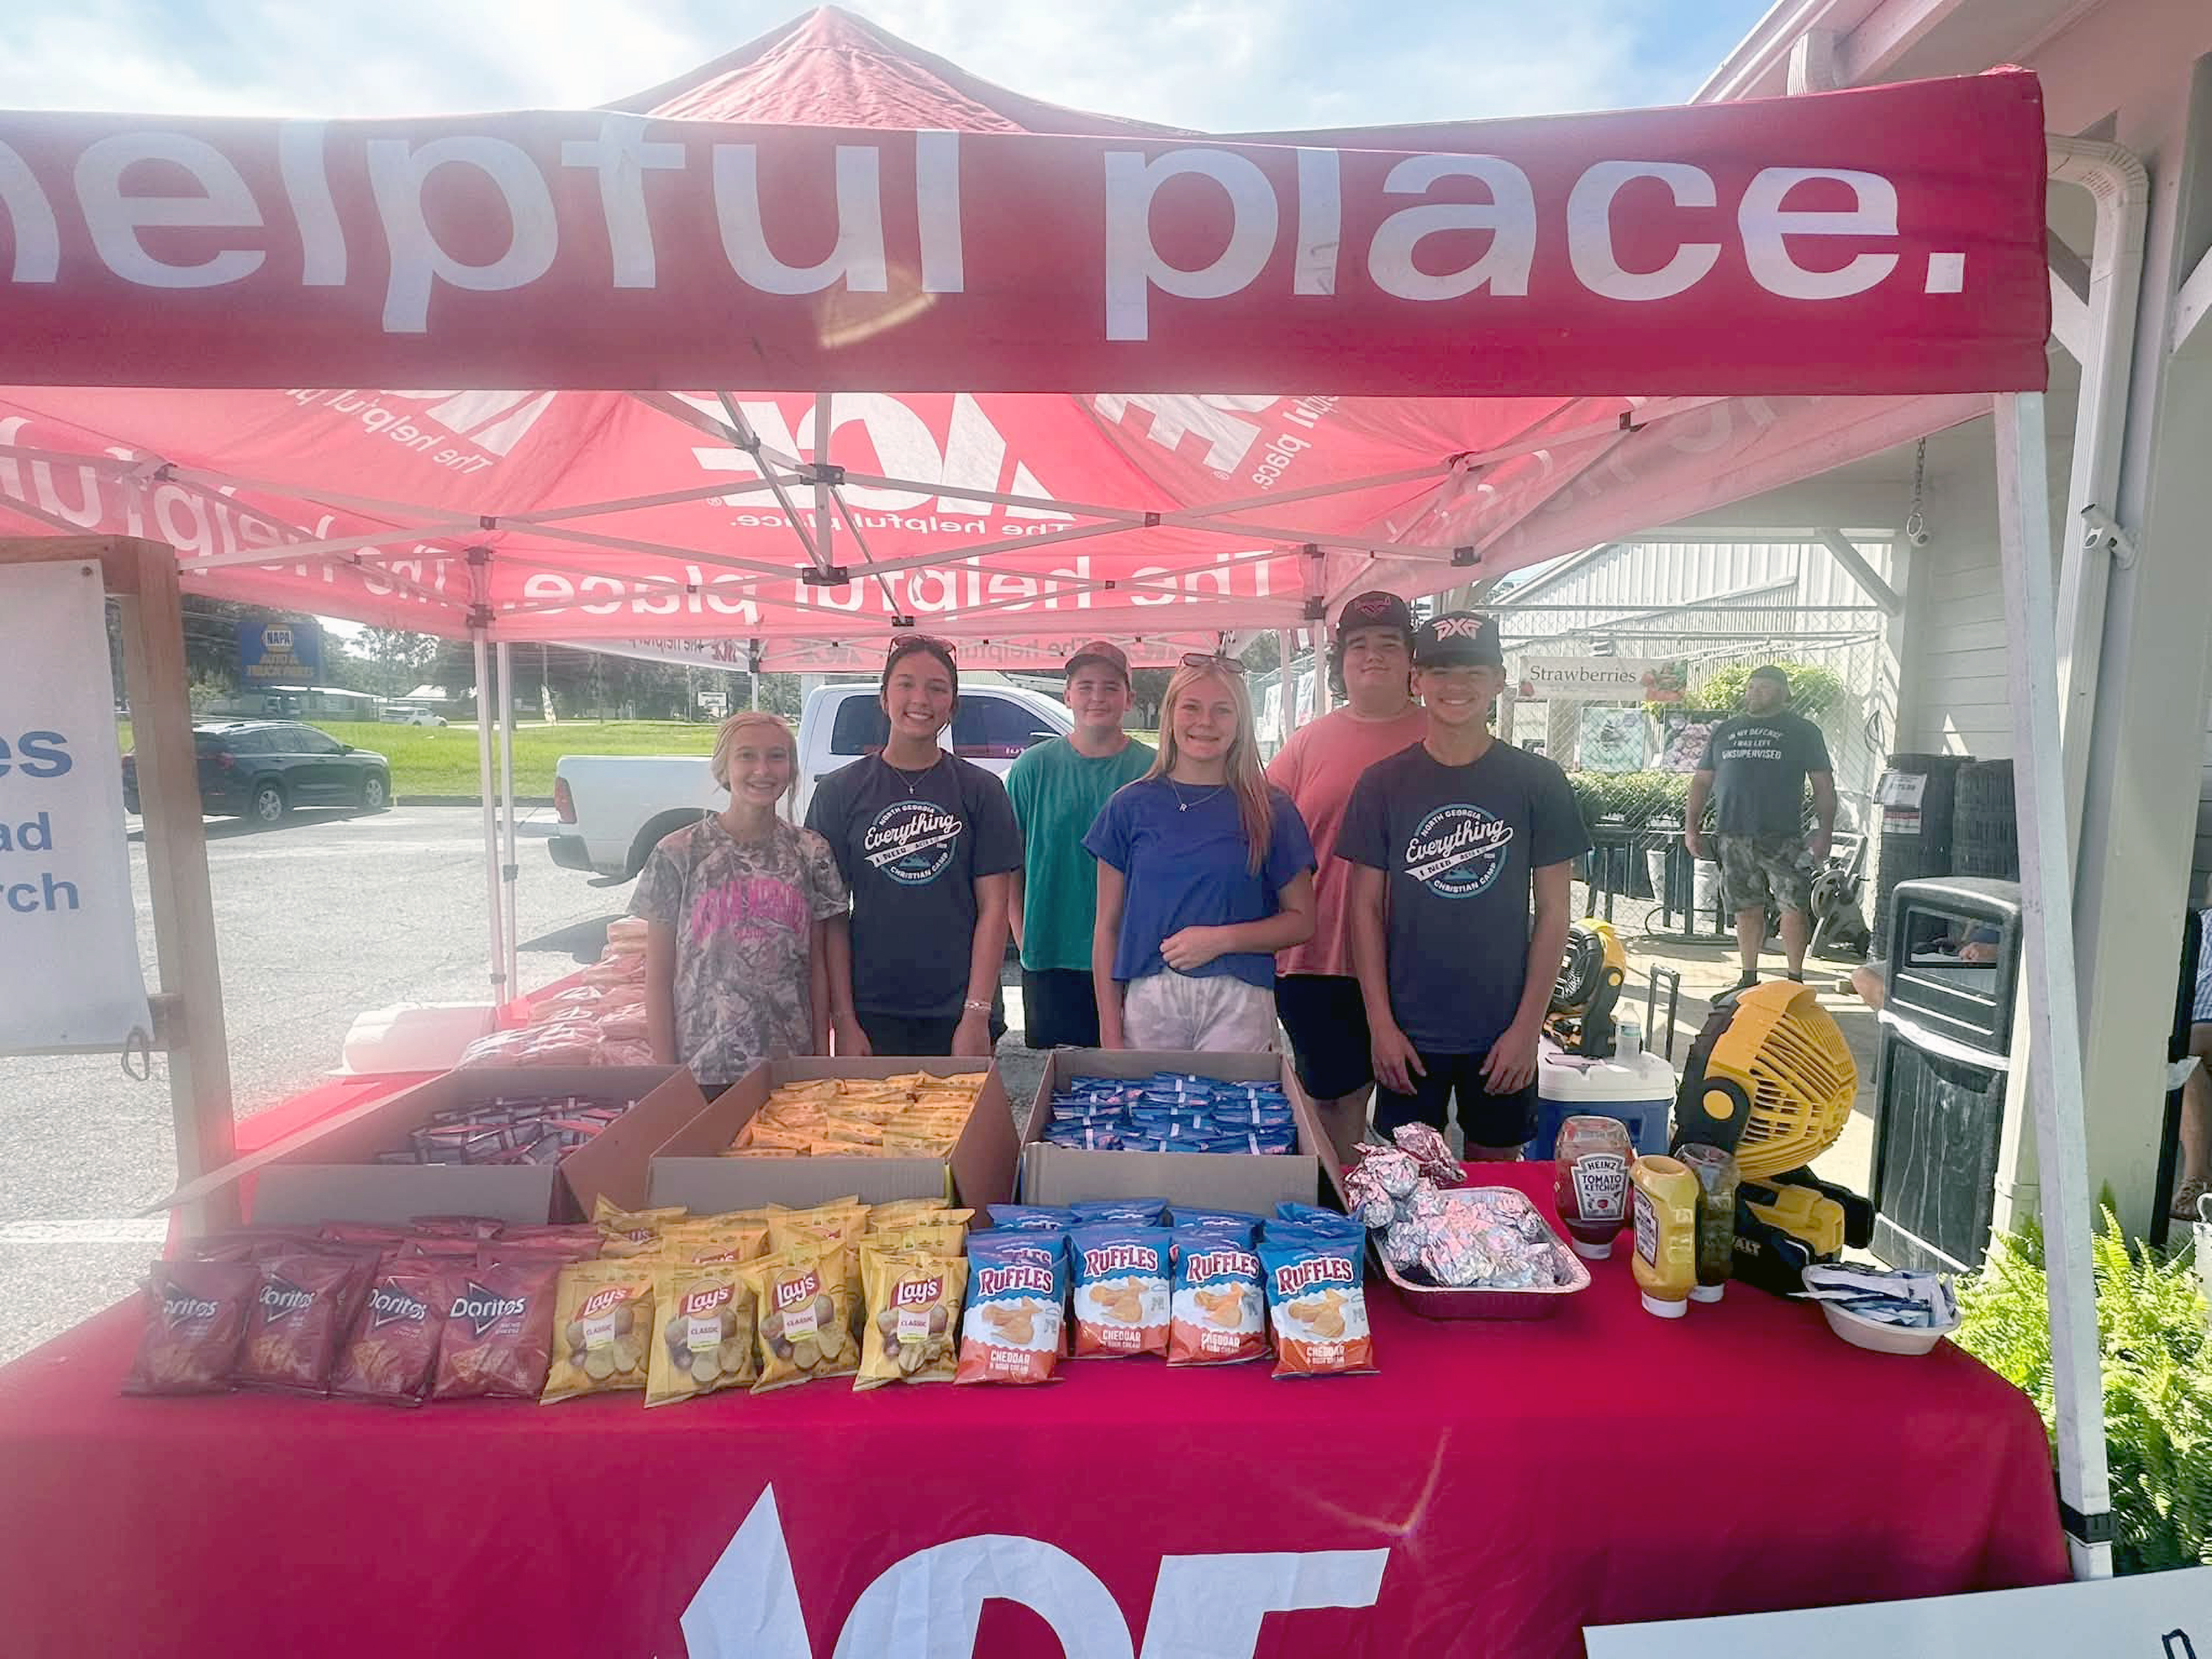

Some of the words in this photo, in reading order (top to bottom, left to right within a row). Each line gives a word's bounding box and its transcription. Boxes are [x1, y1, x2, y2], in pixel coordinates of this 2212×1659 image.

[1103, 146, 1966, 341] place.
[1530, 665, 1637, 683] Strawberries
[0, 731, 72, 778] s
[1722, 749, 1781, 760] UNSUPERVISED
[901, 804, 934, 813] GEORGIA
[864, 812, 962, 851] Everything
[1421, 814, 1444, 837] NORTH
[1445, 809, 1481, 820] GEORGIA
[1405, 819, 1513, 863] Everything
[890, 866, 931, 880] CHRISTIAN
[931, 852, 949, 872] CAMP
[1433, 880, 1479, 893] CHRISTIAN
[1479, 862, 1496, 885] CAMP
[0, 872, 80, 913] ch
[1582, 1175, 1622, 1184] TOMATO
[1587, 1161, 1616, 1170] HEINZ
[1585, 1183, 1621, 1192] KETCHUP
[1084, 1245, 1158, 1278] RUFFLES
[1187, 1252, 1261, 1283] RUFFLES
[979, 1266, 1054, 1296] RUFFLES
[1276, 1257, 1354, 1295] RUFFLES
[584, 1288, 627, 1316] Lay's
[686, 1287, 729, 1314] Lay's
[776, 1276, 815, 1308] Lay's
[897, 1279, 938, 1310] Lay's
[450, 1297, 526, 1318] Doritos
[1102, 1330, 1141, 1341] CHEDDAR
[990, 1349, 1031, 1364] CHEDDAR
[1306, 1346, 1345, 1357] CHEDDAR
